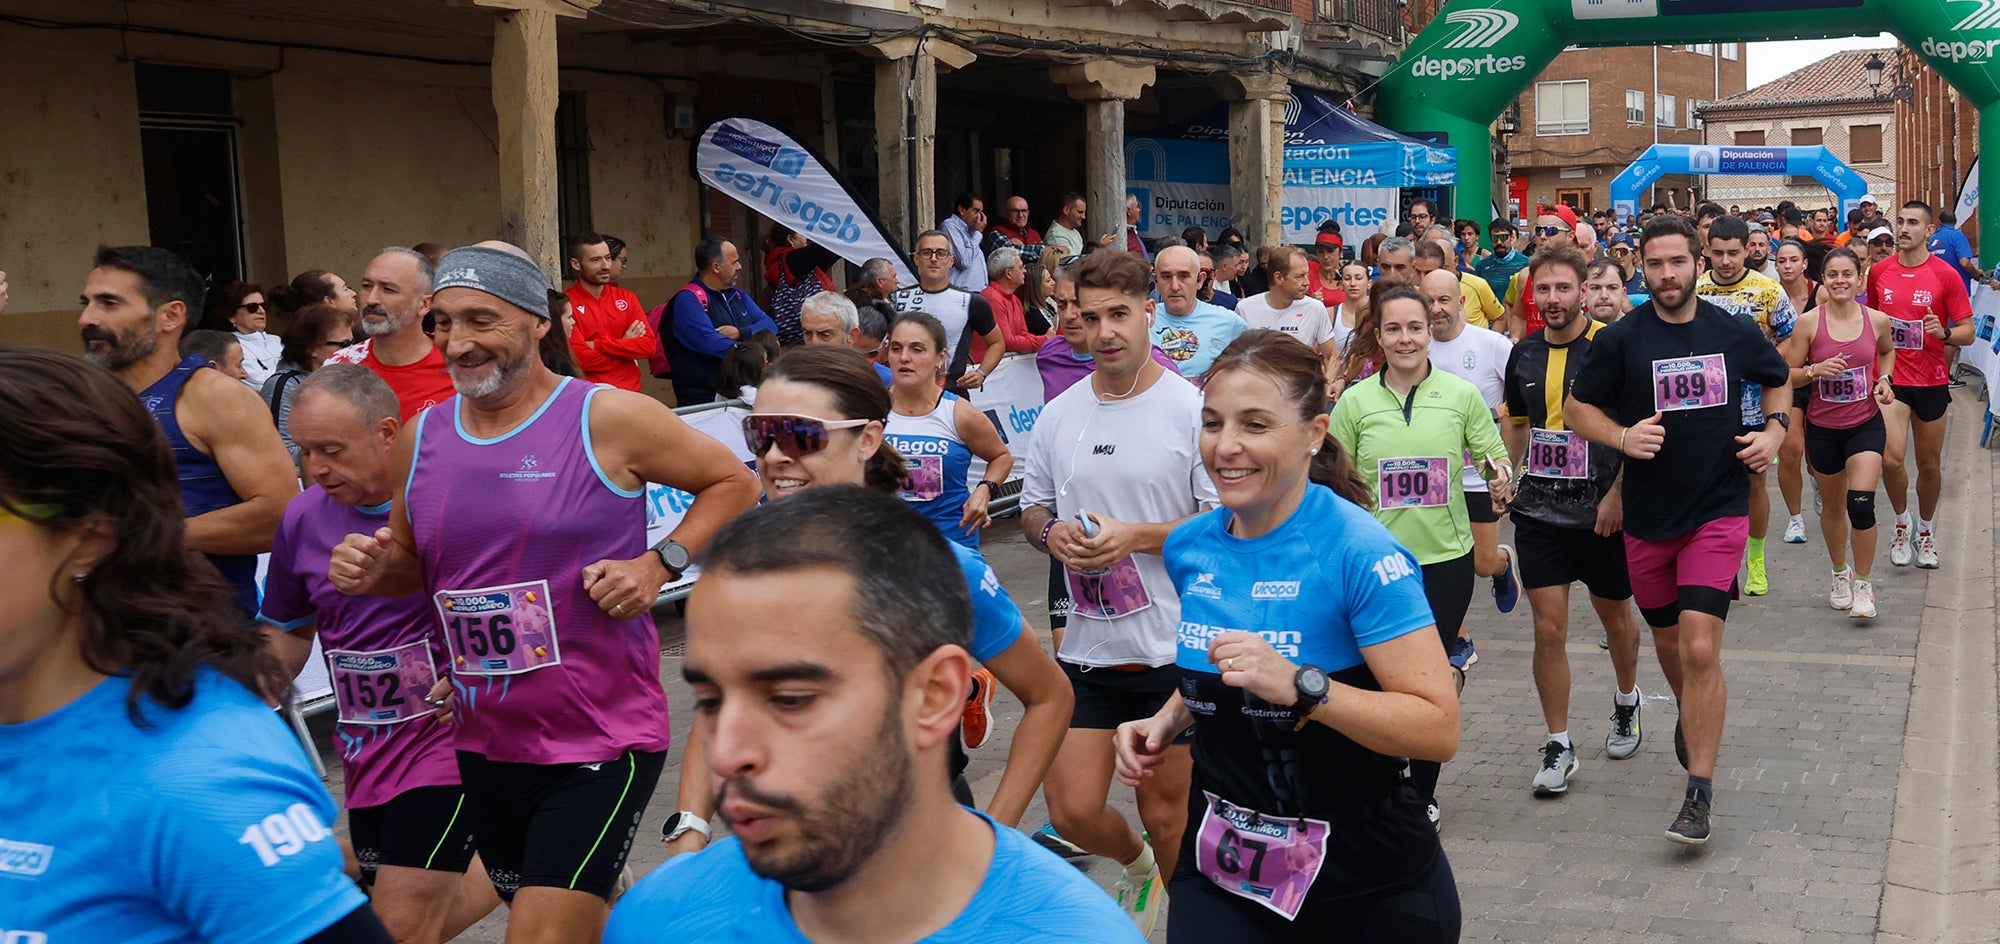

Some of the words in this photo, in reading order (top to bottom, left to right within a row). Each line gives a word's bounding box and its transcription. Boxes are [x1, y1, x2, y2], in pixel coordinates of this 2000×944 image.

[1412, 54, 1526, 81] deportes
[1722, 150, 1774, 161] Diputación
[1722, 161, 1736, 170] DE
[1738, 161, 1786, 170] PALENCIA
[1631, 164, 1661, 191] deportes
[1816, 165, 1848, 190] deportes
[1155, 197, 1225, 212] Diputación
[1155, 215, 1174, 225] DE
[1659, 372, 1706, 399] 189
[1822, 379, 1855, 396] 185
[1092, 444, 1117, 455] M4U
[1532, 443, 1568, 467] 188
[1383, 472, 1428, 497] 190
[1079, 575, 1110, 607] 82
[1253, 582, 1299, 598] vicapal
[450, 614, 515, 657] 156
[339, 672, 405, 709] 152
[1241, 706, 1293, 718] Gestinver
[1215, 828, 1268, 882] 67
